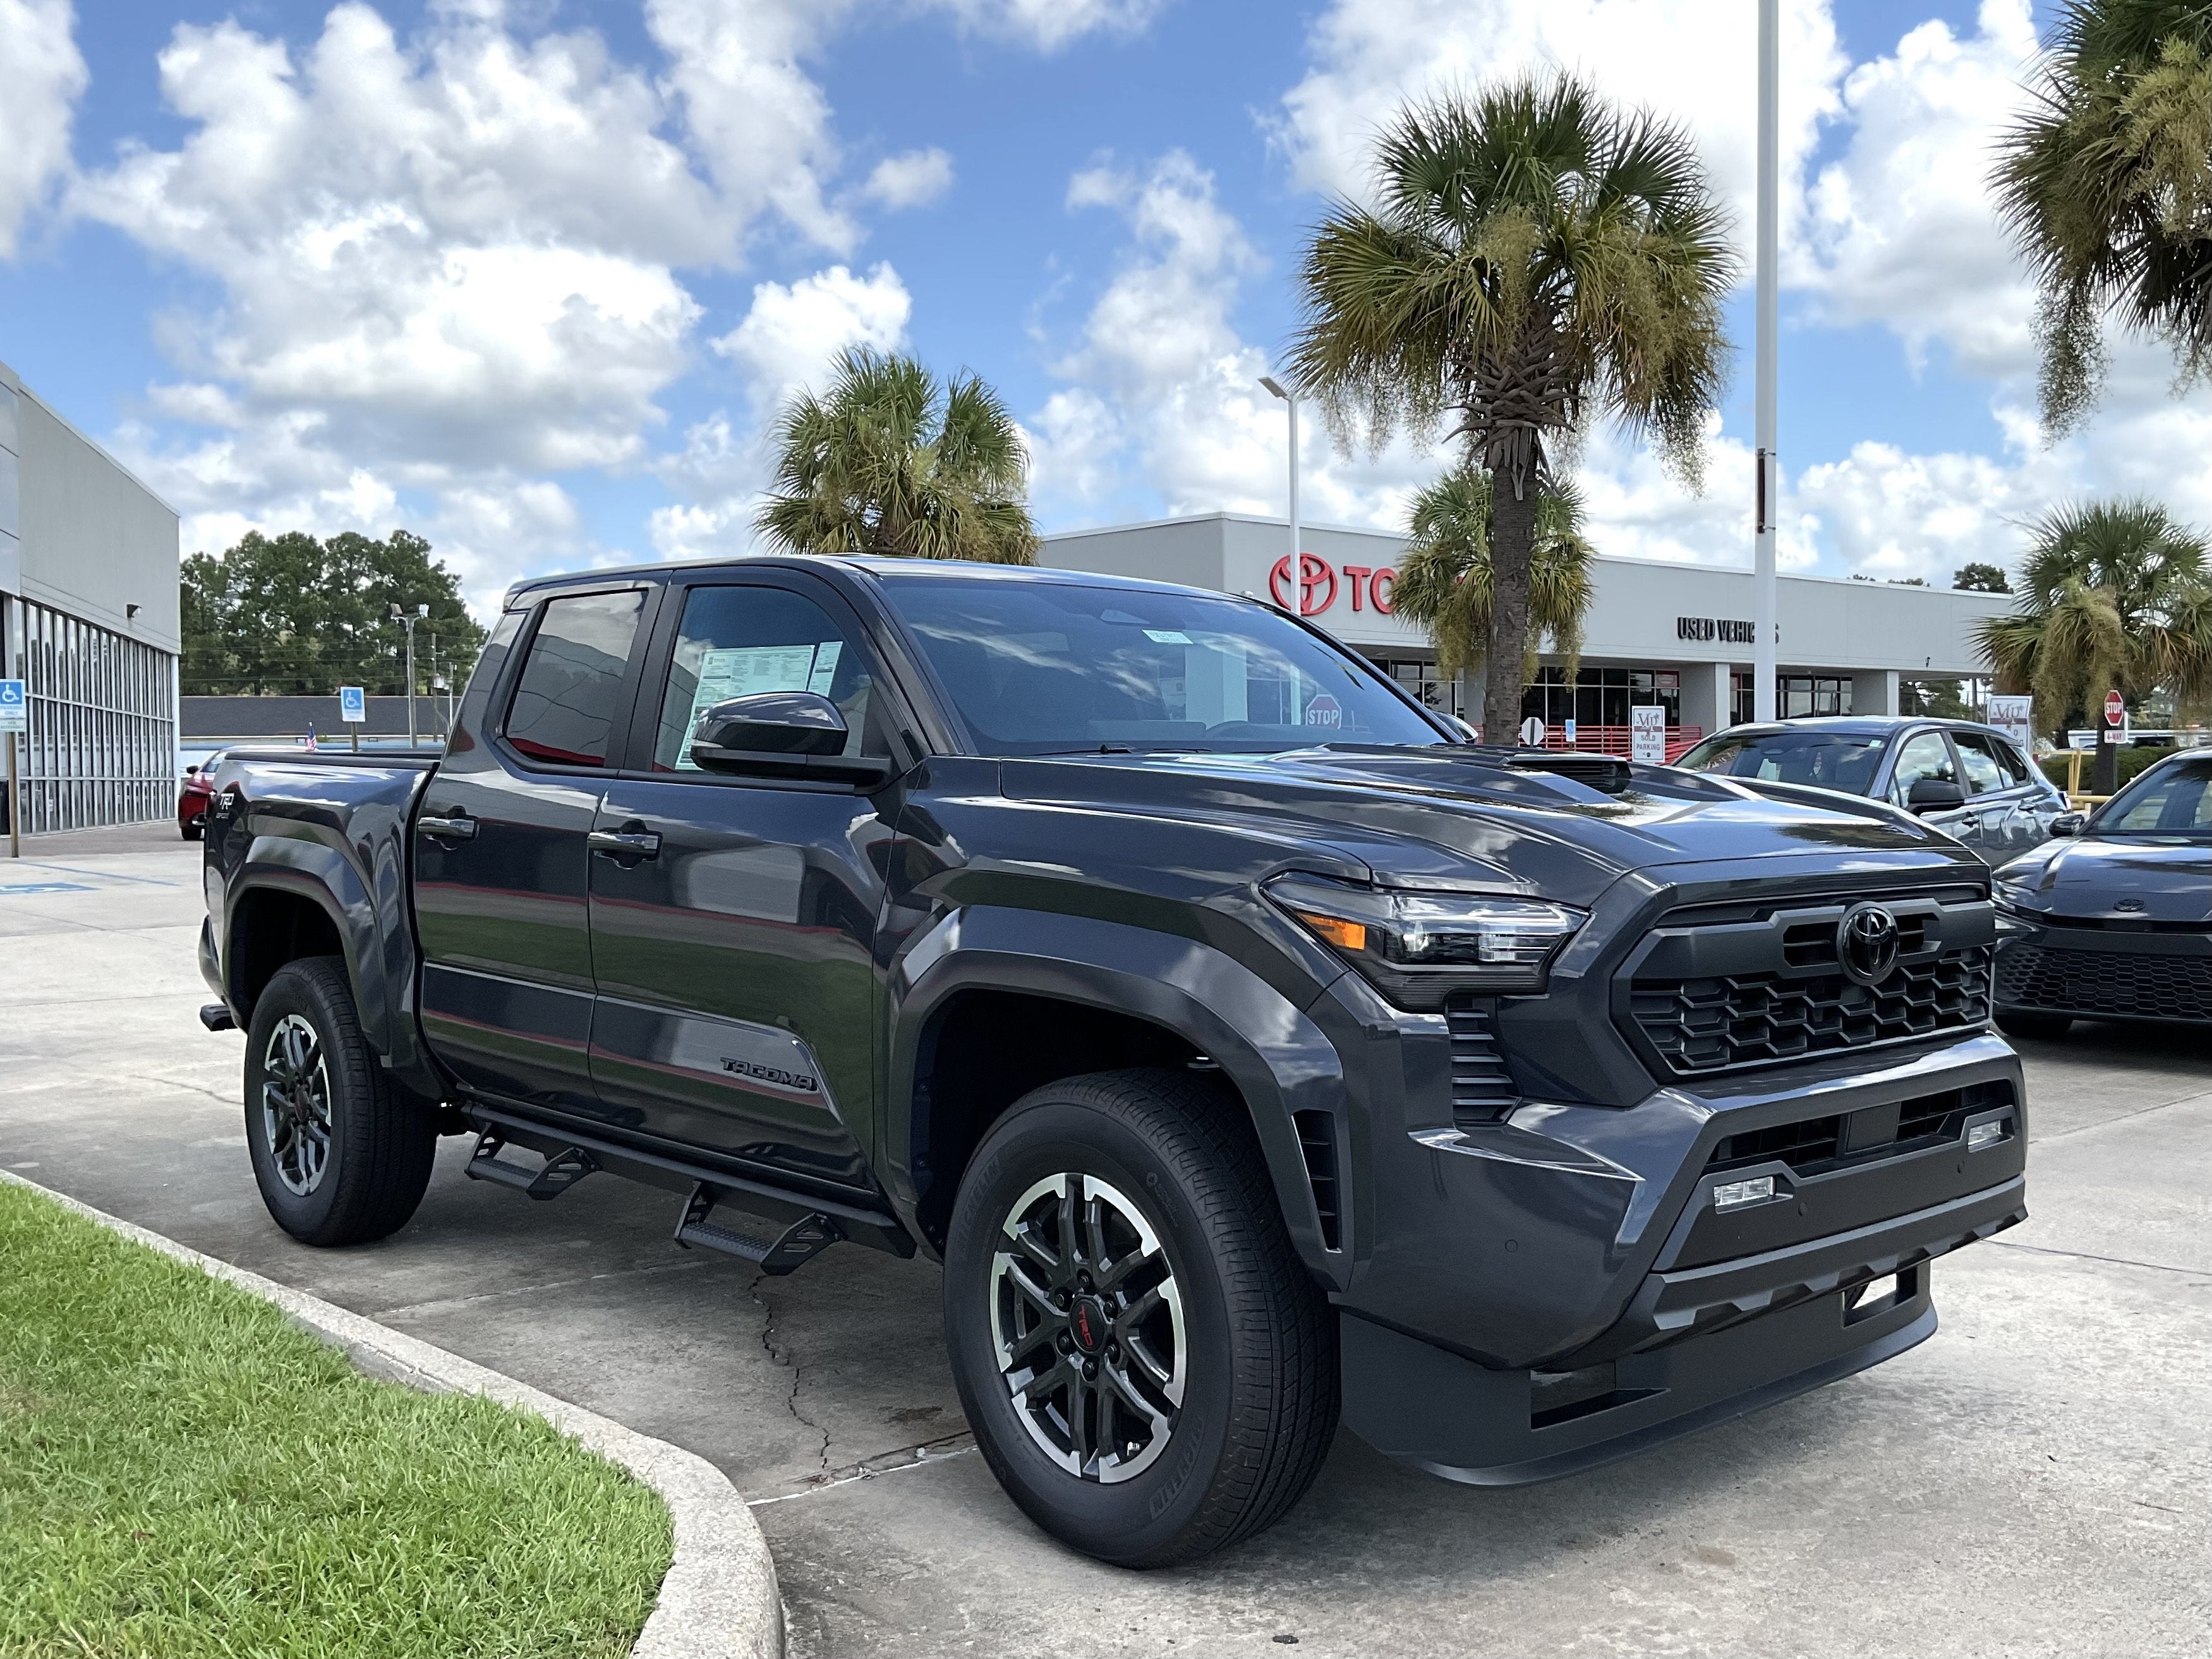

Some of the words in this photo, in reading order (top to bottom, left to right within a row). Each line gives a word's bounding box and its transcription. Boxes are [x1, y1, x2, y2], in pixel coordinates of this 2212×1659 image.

[1677, 617, 1715, 641] USED
[1716, 619, 1779, 644] VEHIC
[1308, 709, 1339, 725] STOP
[2106, 702, 2122, 715] STOP
[2106, 733, 2122, 741] 4-WAY
[219, 793, 235, 811] TRD
[720, 1056, 818, 1092] TACOMA
[1079, 1303, 1094, 1346] TRD
